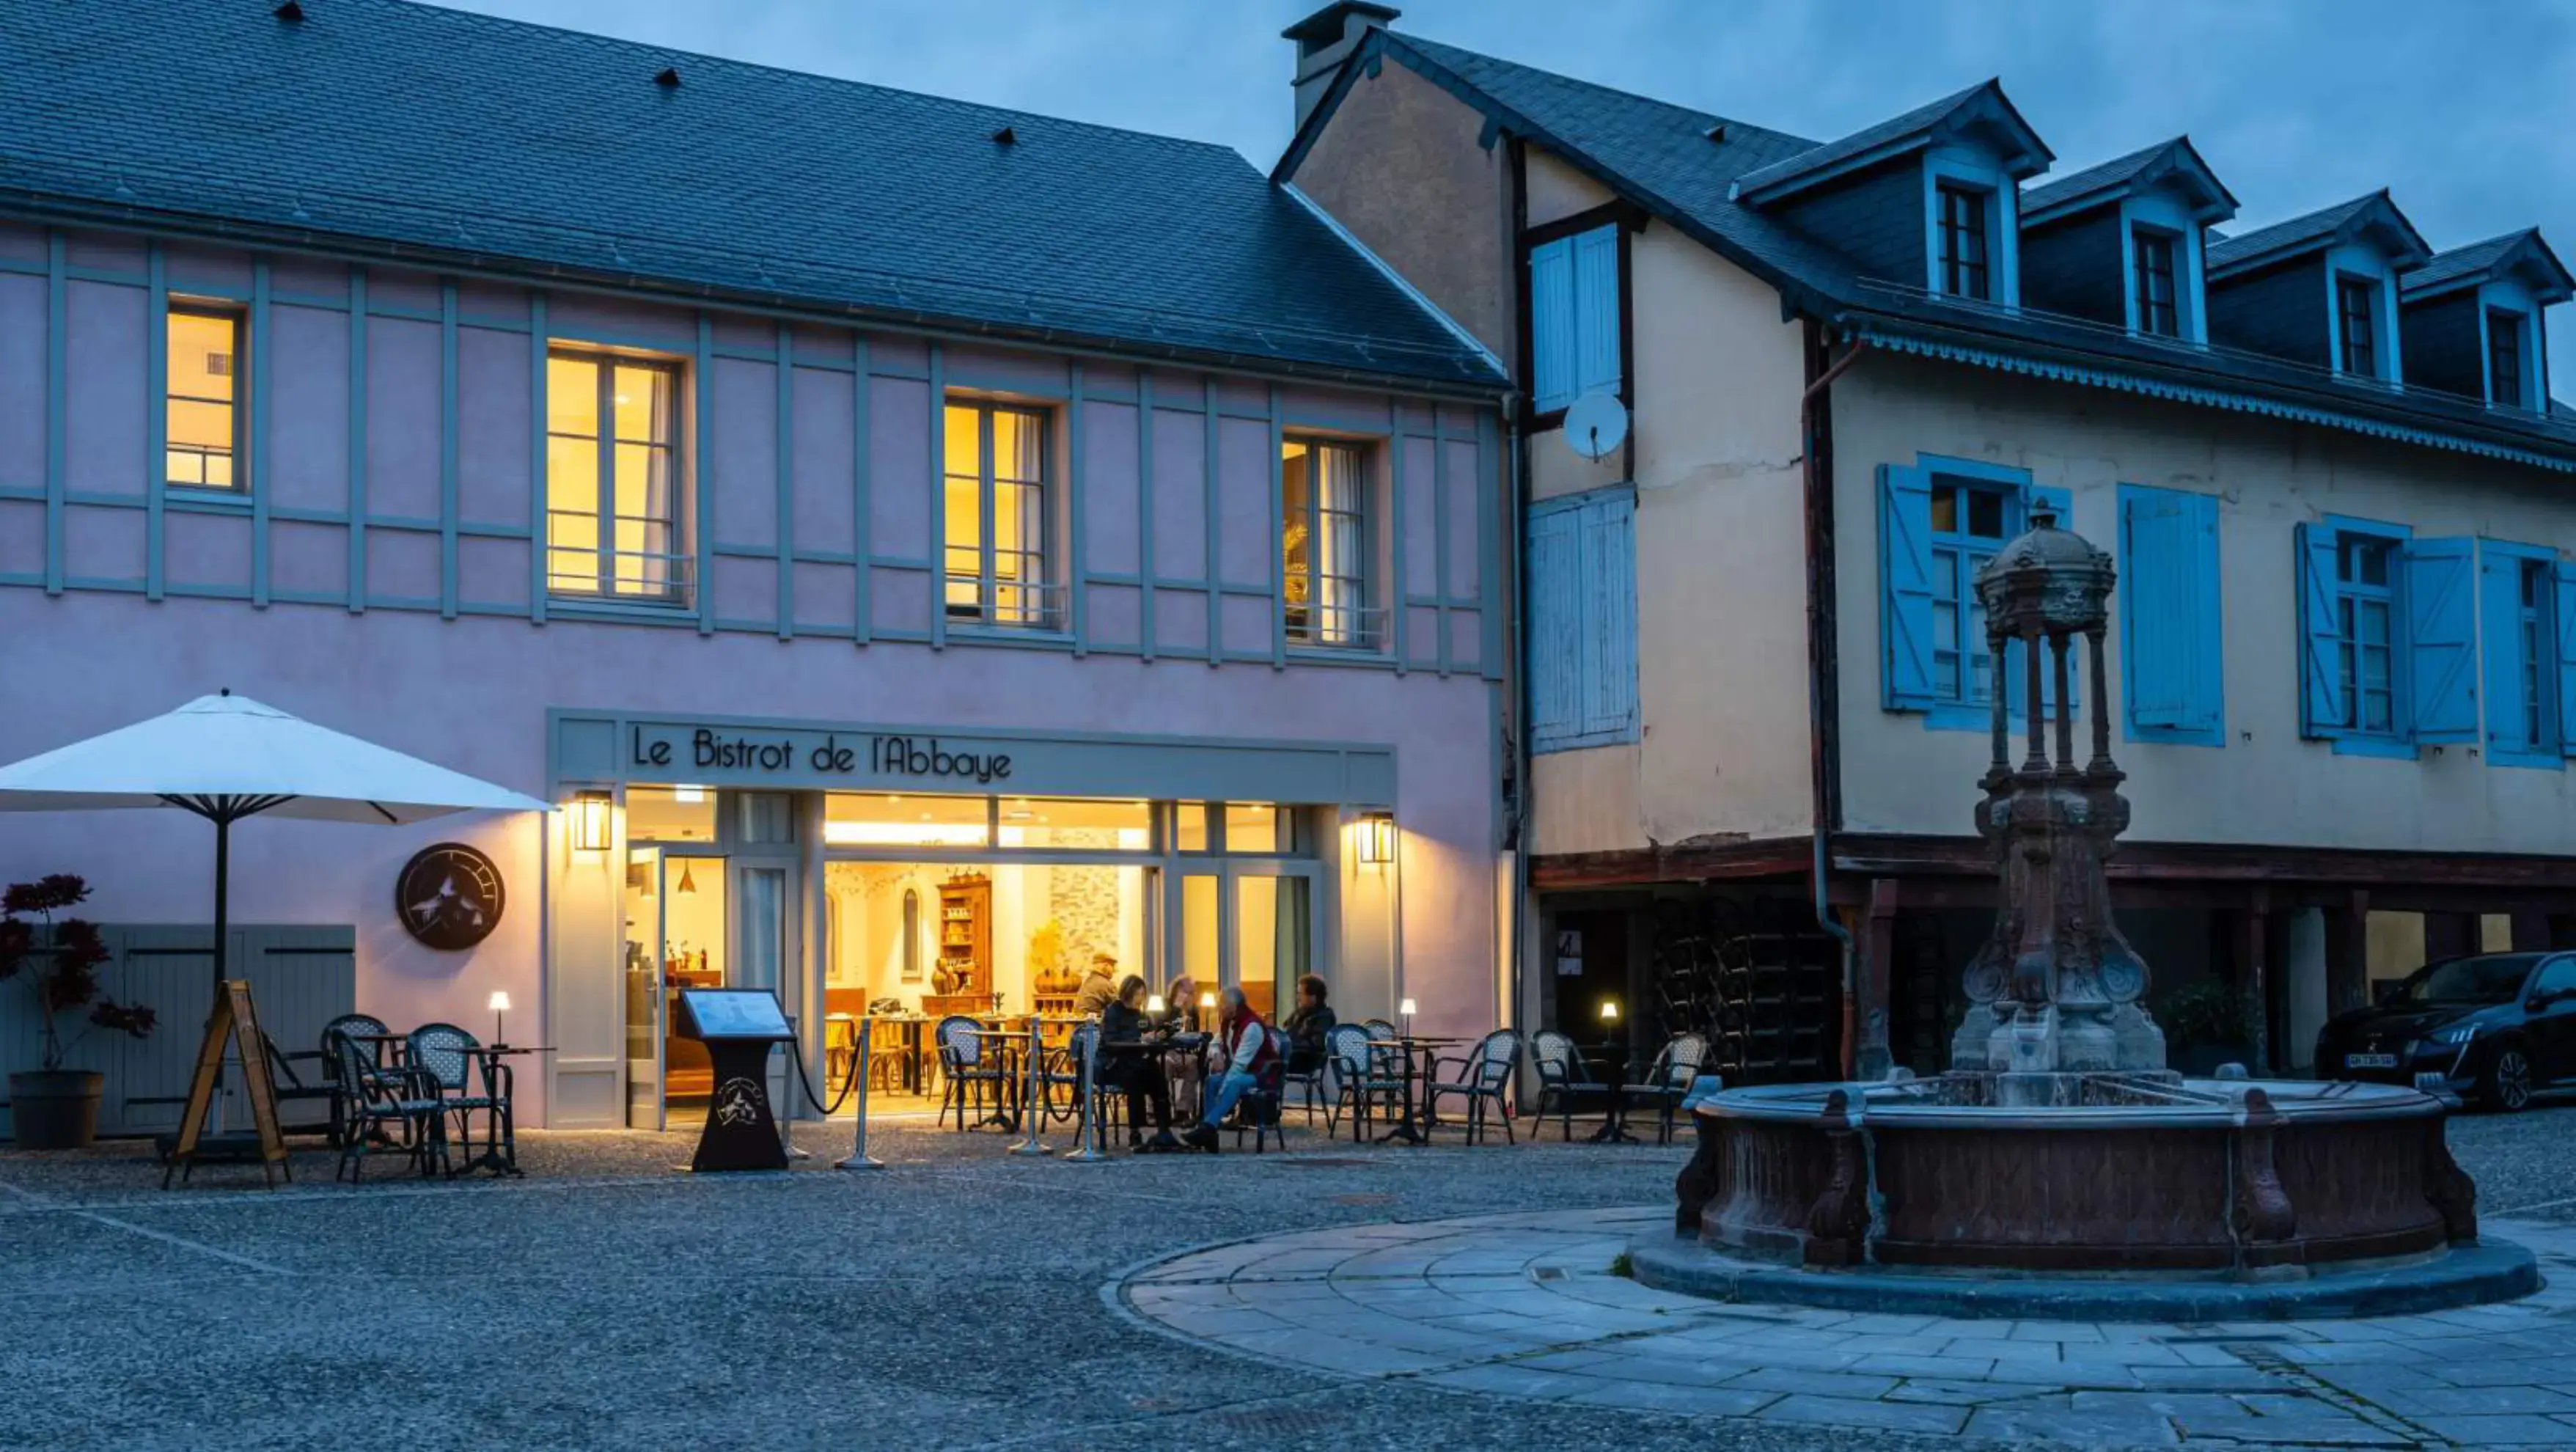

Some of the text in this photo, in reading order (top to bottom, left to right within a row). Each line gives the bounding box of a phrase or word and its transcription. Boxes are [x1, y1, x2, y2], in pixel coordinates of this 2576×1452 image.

[635, 725, 1012, 783] Le Bistrot de l'Abbaye
